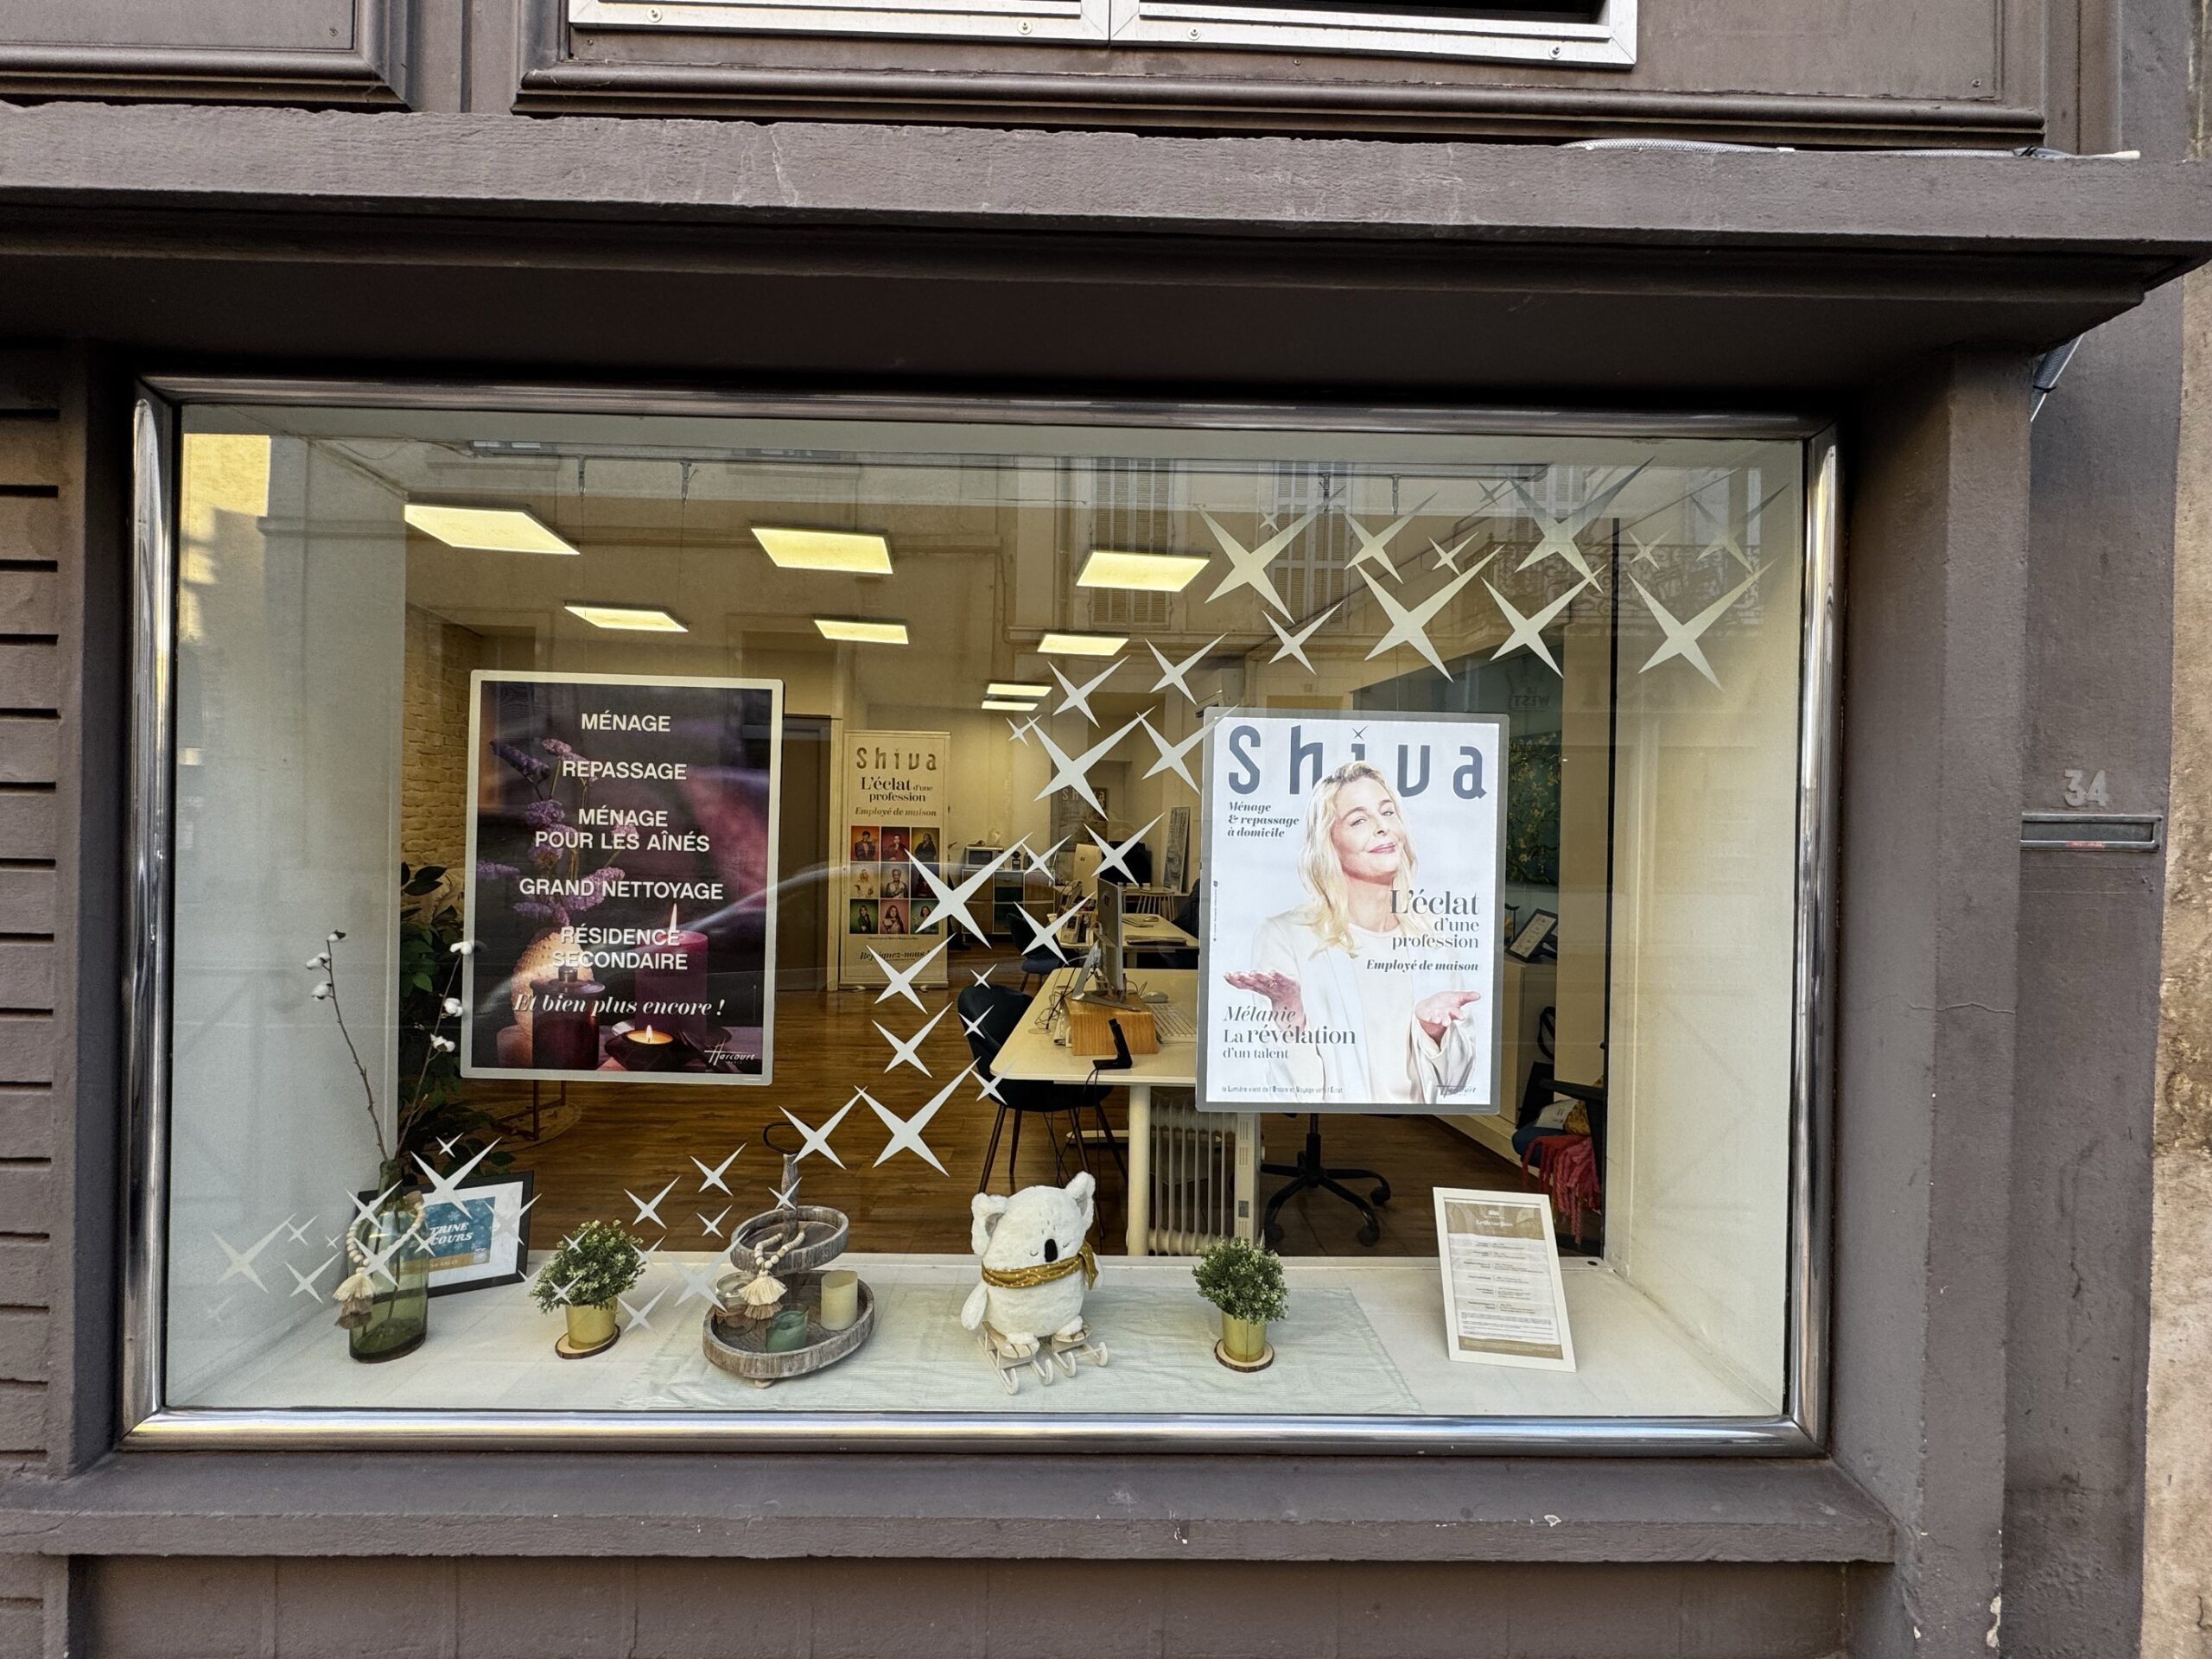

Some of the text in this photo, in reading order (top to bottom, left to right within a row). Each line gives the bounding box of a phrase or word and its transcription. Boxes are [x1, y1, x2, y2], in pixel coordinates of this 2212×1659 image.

[582, 709, 671, 732] MÉNAGE
[856, 747, 937, 771] Shiva
[1228, 725, 1487, 800] Shiva
[563, 760, 687, 780] REPASSAGE
[861, 776, 911, 791] L'éclat
[2063, 768, 2109, 807] 34
[869, 792, 926, 803] profession
[1229, 801, 1271, 814] Ménage
[578, 804, 669, 827] MÉNAGE
[855, 806, 937, 817] Employé de maison
[1228, 814, 1300, 828] & repassage
[535, 830, 710, 853] POUR LES AÎNÉS
[1227, 827, 1285, 838] à domicile
[519, 878, 723, 900] GRAND NETTOYAGE
[1389, 888, 1480, 915] L'éclat
[1434, 917, 1480, 932] d'une
[561, 924, 681, 947] RÉSIDENCE
[1392, 934, 1479, 950] profession
[552, 950, 689, 970] SECONDAIRE
[1366, 958, 1479, 973] Employé de maison
[512, 994, 726, 1017] Et bien plus encore !
[1223, 1005, 1297, 1022] Mélanie
[1224, 1023, 1356, 1045] La révélation
[1223, 1047, 1289, 1059] d'un talent
